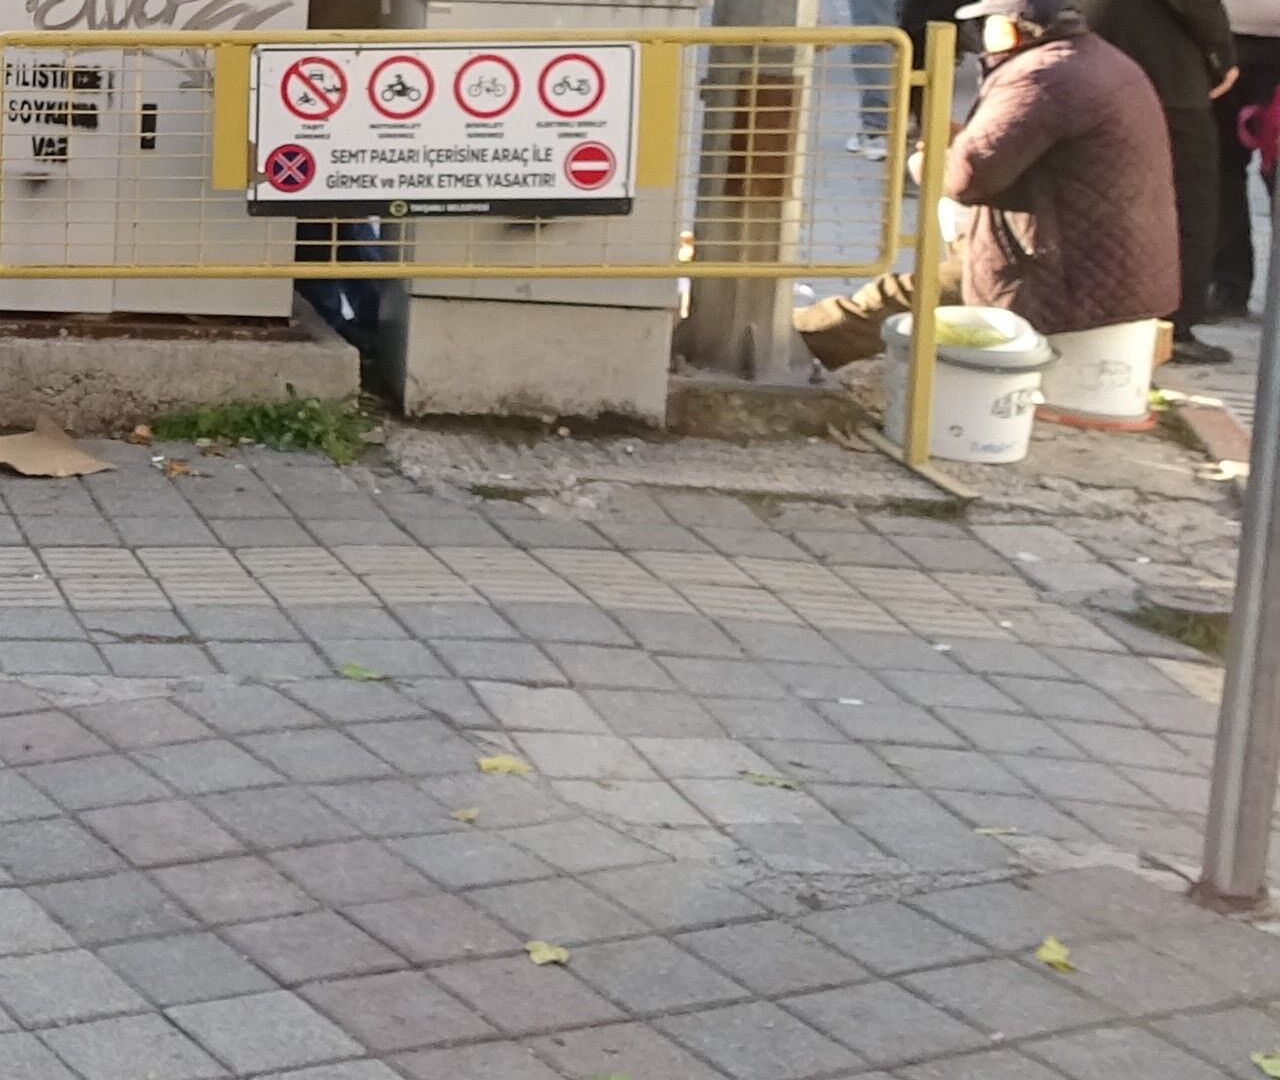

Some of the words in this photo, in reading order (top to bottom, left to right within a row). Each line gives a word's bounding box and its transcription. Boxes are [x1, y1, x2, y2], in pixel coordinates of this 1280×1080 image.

[330, 148, 366, 164] SEMT
[370, 148, 419, 164] PAZARI
[423, 144, 489, 167] İÇERİSİNE
[491, 147, 528, 167] ARAÇ
[532, 143, 553, 163] İLE
[326, 172, 377, 189] GİRMEK
[381, 176, 395, 188] ve
[398, 174, 434, 189] PARK
[438, 174, 481, 188] ETMEK
[485, 172, 556, 188] YASAKTIR!
